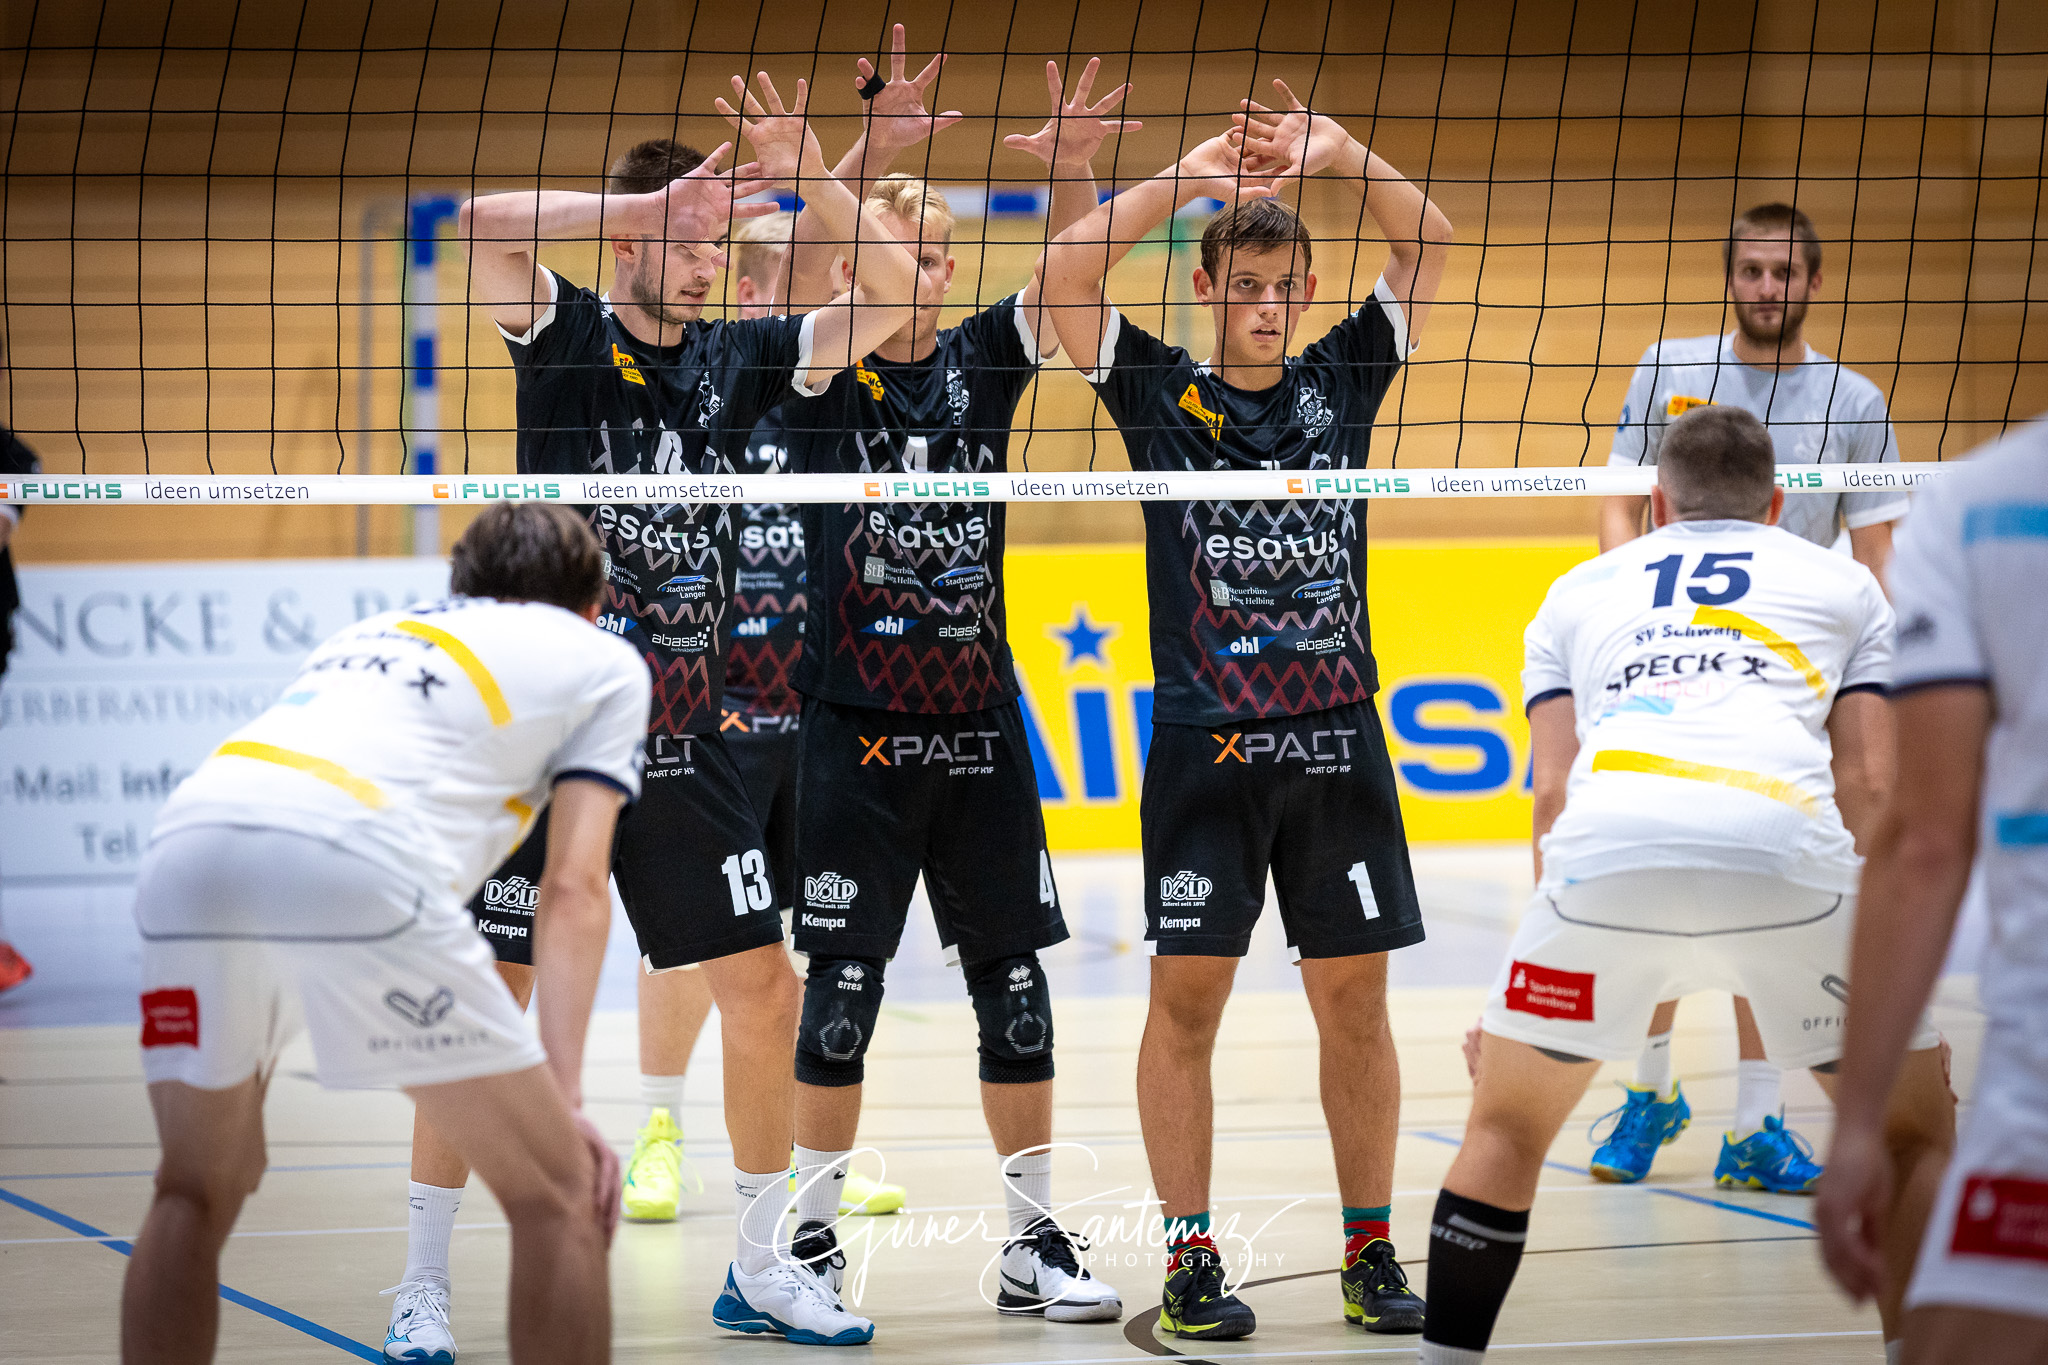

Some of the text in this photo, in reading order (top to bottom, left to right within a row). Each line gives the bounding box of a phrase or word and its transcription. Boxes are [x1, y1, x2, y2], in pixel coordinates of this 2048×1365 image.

[1316, 477, 1410, 493] FUCHS
[1432, 476, 1586, 492] Ideen umsetzen
[1843, 470, 1896, 487] Ideen
[22, 483, 122, 499] FUCHS
[145, 482, 309, 500] Ideen umsetzen
[462, 483, 561, 499] FUCHS
[583, 482, 744, 499] Ideen umsetzen
[893, 481, 990, 497] FUCHS
[1011, 479, 1169, 496] Ideen umsetzen
[1206, 529, 1339, 560] esatus
[864, 562, 885, 578] StB
[666, 583, 706, 593] Stadtwerke
[946, 573, 984, 587] Stadtwerke
[1644, 552, 1754, 609] 15
[680, 590, 706, 600] Langen
[1211, 586, 1229, 600] StB
[1304, 585, 1341, 599] Stadtwerke
[1316, 592, 1341, 605] Langen
[1245, 597, 1275, 606] Helbing
[596, 613, 627, 635] ohl
[738, 616, 768, 636] ohl
[874, 616, 904, 635] ohl
[938, 624, 978, 638] abass
[652, 633, 698, 648] abass
[1230, 636, 1260, 654] ohl
[1296, 638, 1335, 651] abass
[858, 731, 1000, 766] XPACT
[1211, 729, 1357, 764] XPACT
[647, 769, 669, 779] PART
[670, 768, 683, 777] OF
[949, 767, 967, 776] PART
[967, 766, 980, 775] OF
[1305, 766, 1326, 775] PART
[1326, 765, 1338, 774] OF
[721, 849, 773, 916] 13
[1346, 860, 1381, 921] 1
[478, 918, 528, 939] Kempa
[801, 913, 846, 931] Kempa
[1159, 916, 1201, 931] Kempa
[837, 979, 863, 992] errea
[1009, 979, 1034, 993] errea
